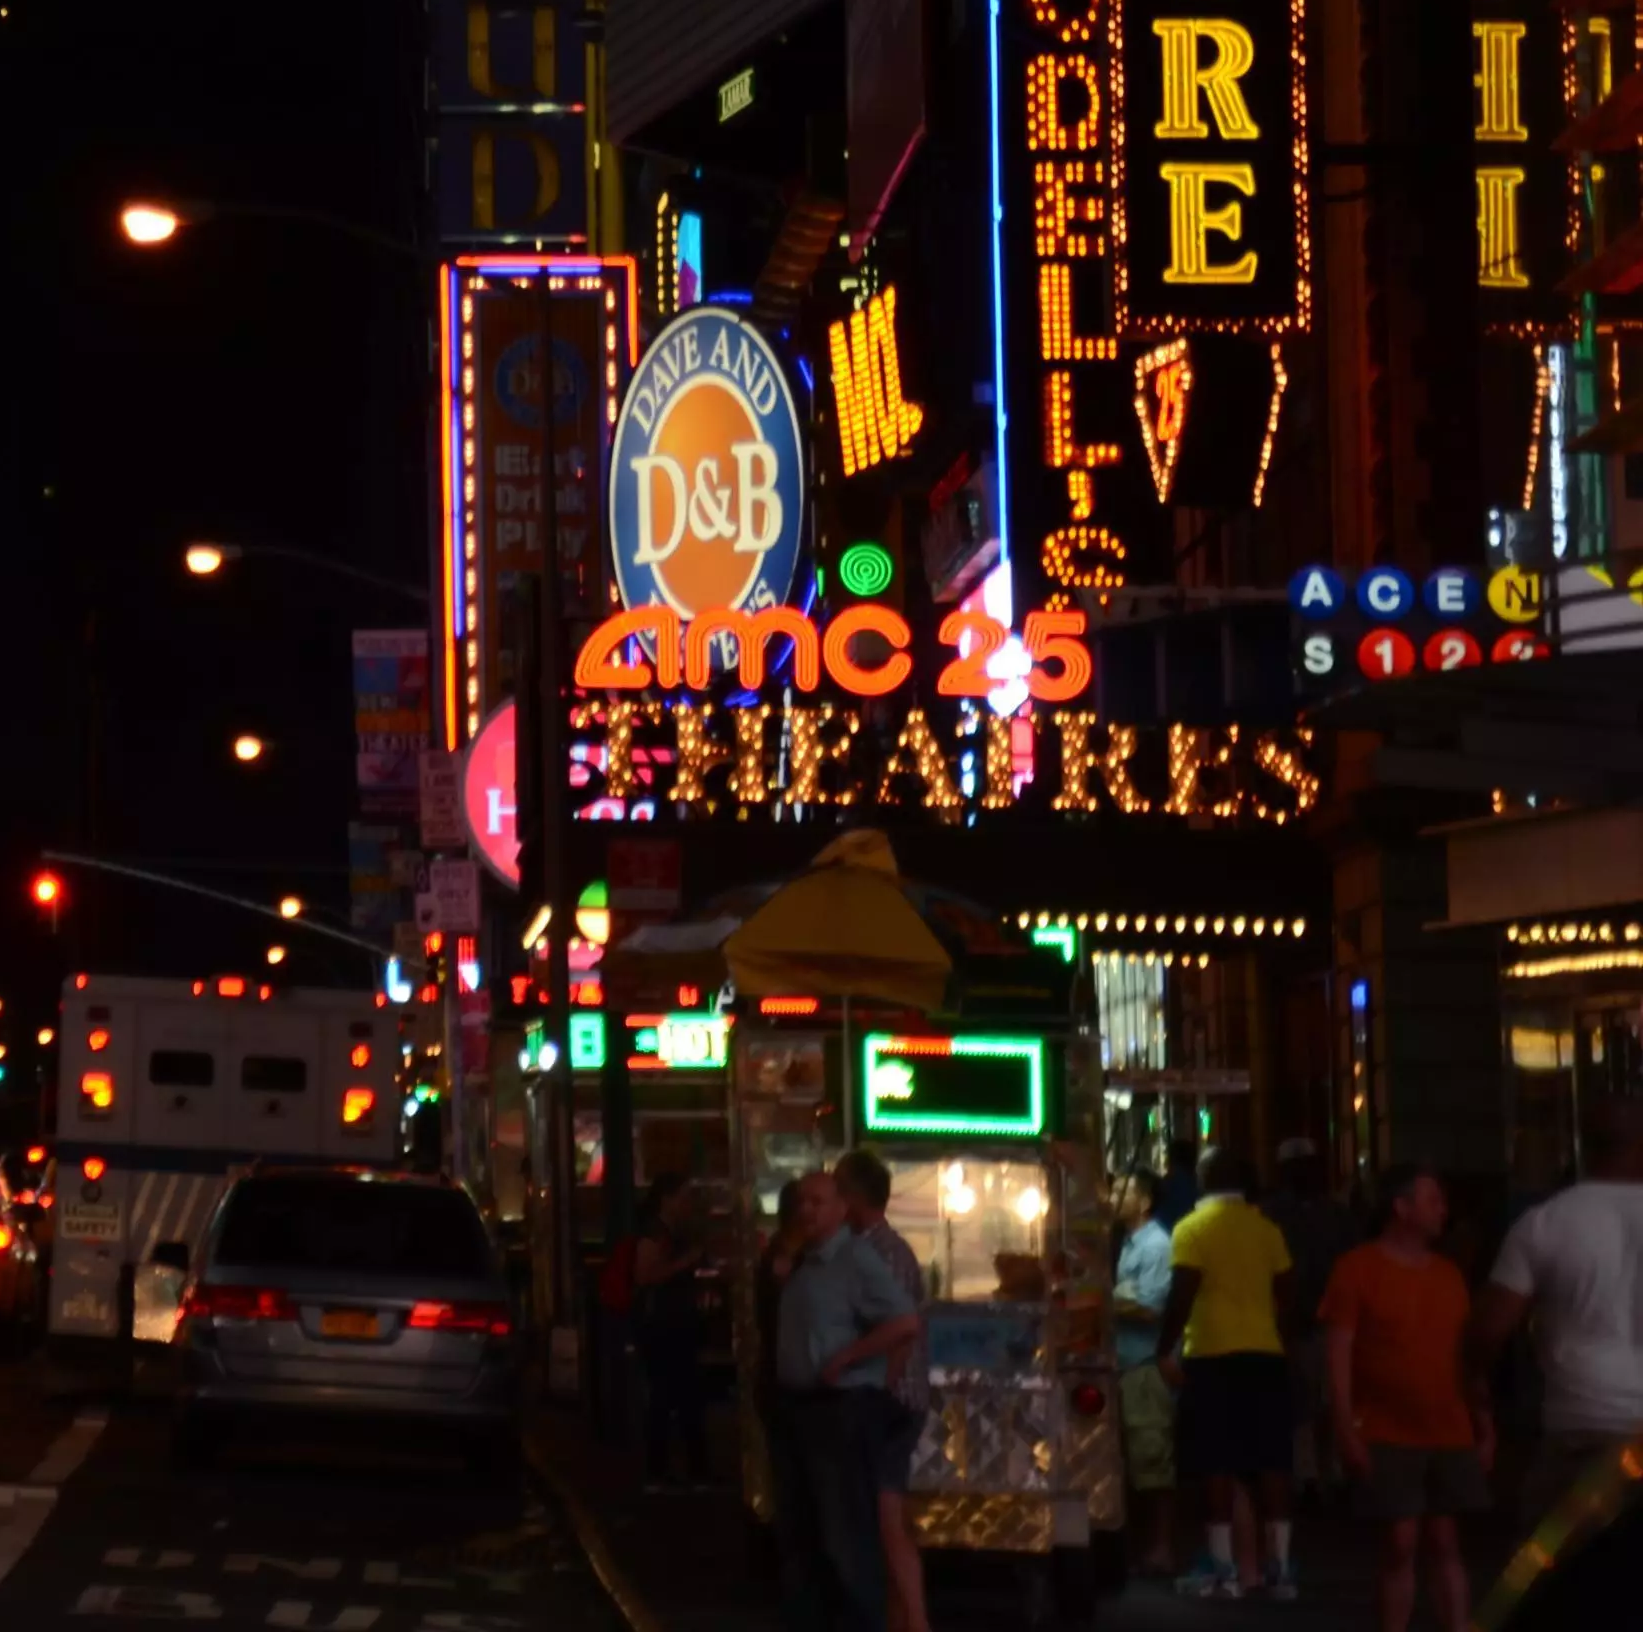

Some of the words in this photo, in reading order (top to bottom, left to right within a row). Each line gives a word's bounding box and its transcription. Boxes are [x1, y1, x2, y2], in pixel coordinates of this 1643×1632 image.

[630, 326, 703, 438] DAVE
[711, 322, 780, 419] AND
[631, 441, 783, 568] D&B
[1300, 569, 1333, 608] A
[1367, 574, 1401, 612] C
[1437, 576, 1466, 612] E
[937, 608, 1094, 702] 25
[1303, 634, 1334, 675] S
[571, 700, 1319, 827] THEATRES
